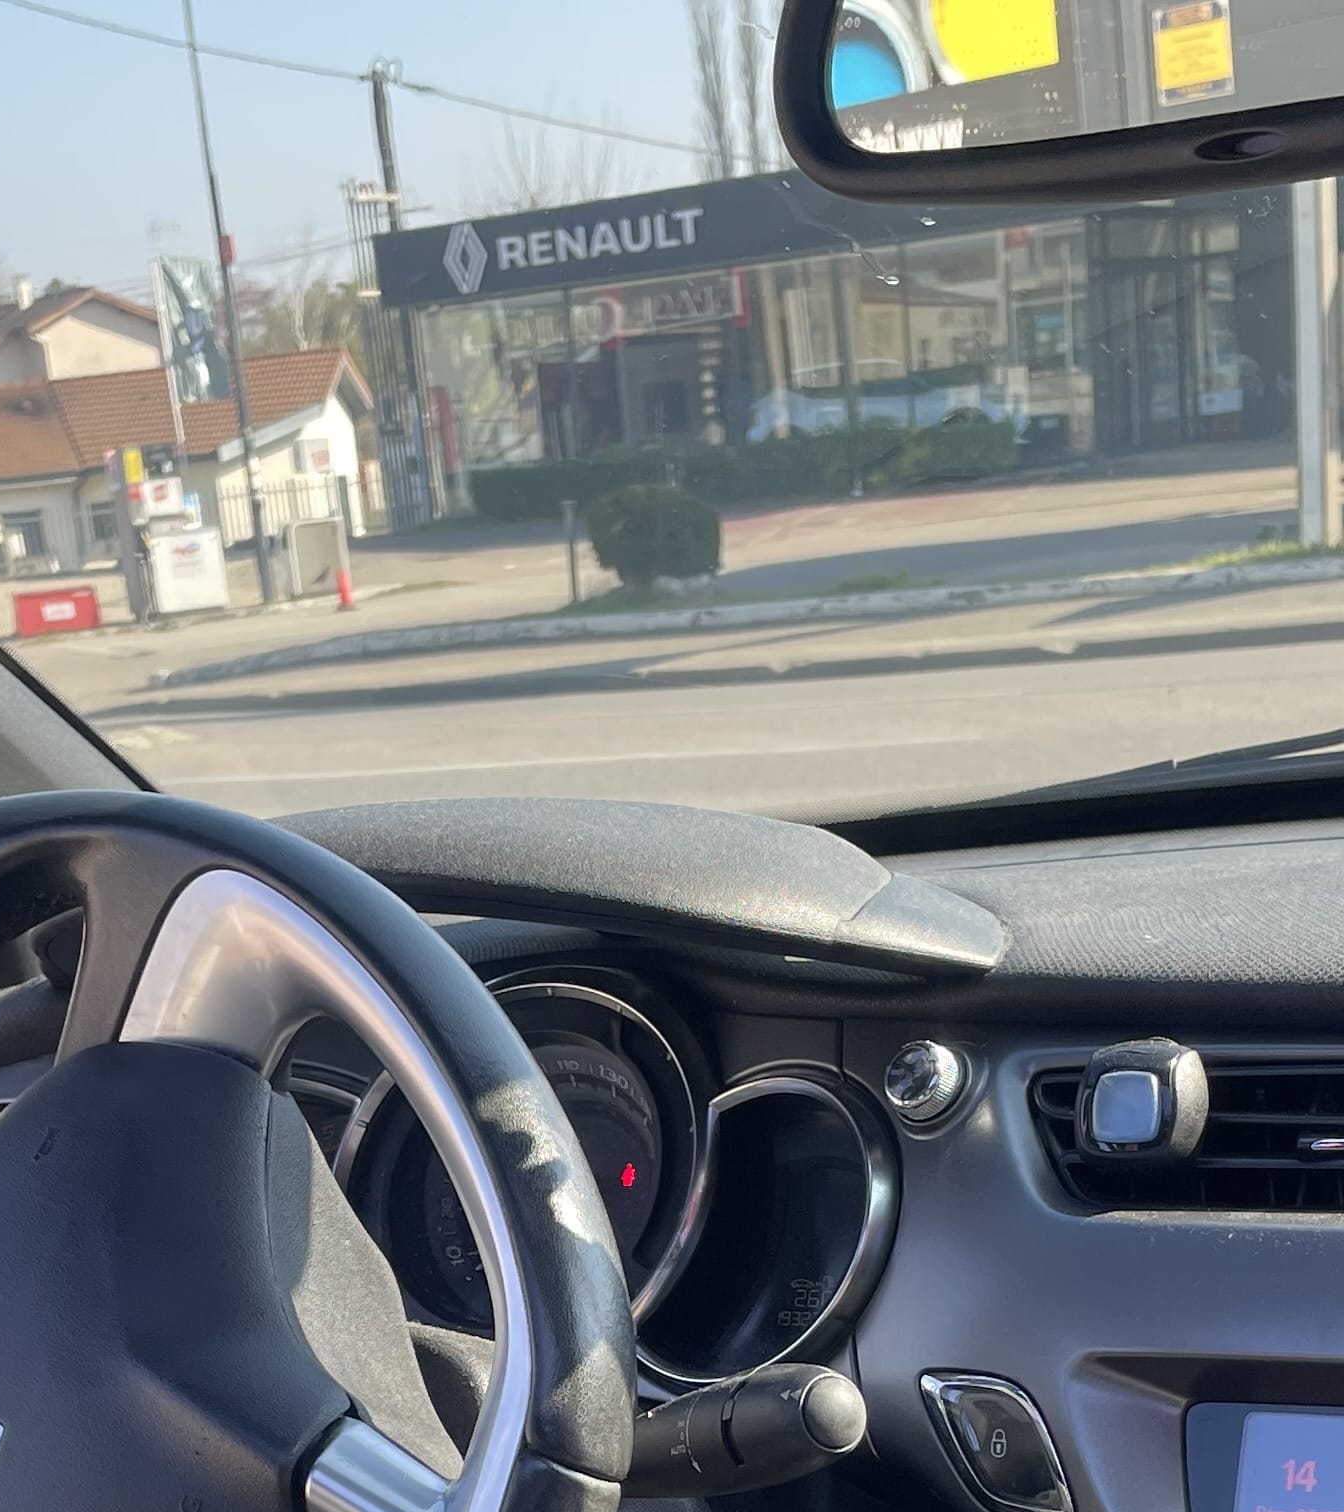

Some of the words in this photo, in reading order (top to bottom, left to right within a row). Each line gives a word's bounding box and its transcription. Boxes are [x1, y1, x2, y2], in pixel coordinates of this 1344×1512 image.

[495, 209, 704, 271] RENAULT
[599, 1064, 629, 1089] 130
[1283, 1459, 1318, 1493] 14
